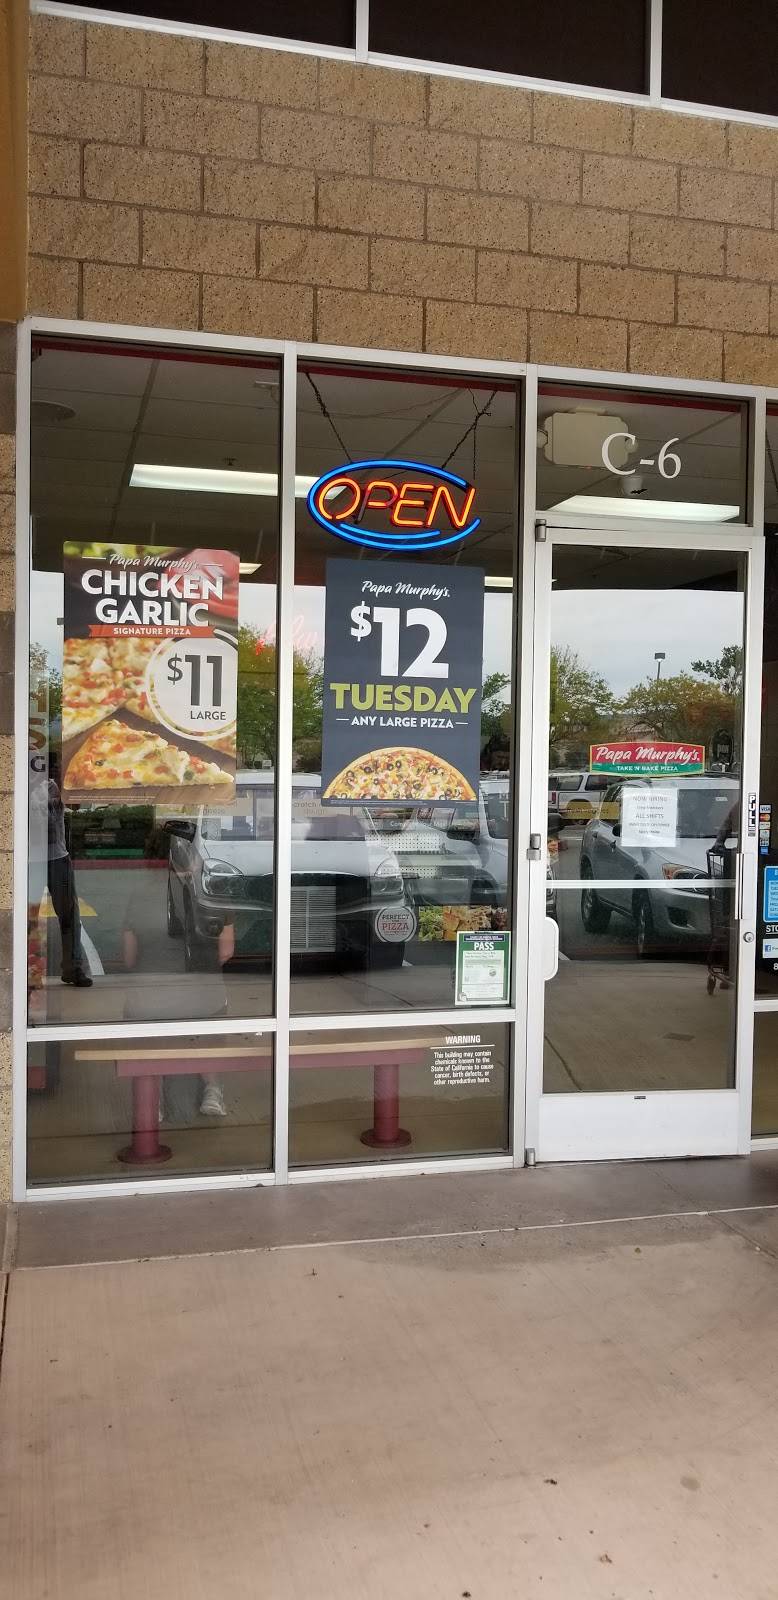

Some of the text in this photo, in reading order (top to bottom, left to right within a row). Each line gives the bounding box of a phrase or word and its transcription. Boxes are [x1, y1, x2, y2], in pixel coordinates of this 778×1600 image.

[601, 432, 682, 479] C-6
[317, 476, 477, 529] OPEN
[109, 553, 140, 570] Papa
[81, 568, 224, 601] CHICKEN
[361, 580, 392, 598] Papa
[95, 597, 210, 627] GARLIC
[113, 627, 191, 636] SIGNATURE PIZZA
[350, 600, 450, 679] $12
[167, 652, 223, 707] $11
[329, 682, 477, 714] TUESDAY
[190, 710, 227, 721] LARGE
[351, 716, 454, 729] ANY LARGE PIZZA
[596, 746, 631, 765] Papa
[748, 795, 756, 827] PULL
[382, 922, 410, 931] PIZZA
[473, 941, 495, 951] PASS
[445, 1034, 481, 1045] WARNING
[444, 1051, 463, 1059] building
[452, 1070, 464, 1078] birth
